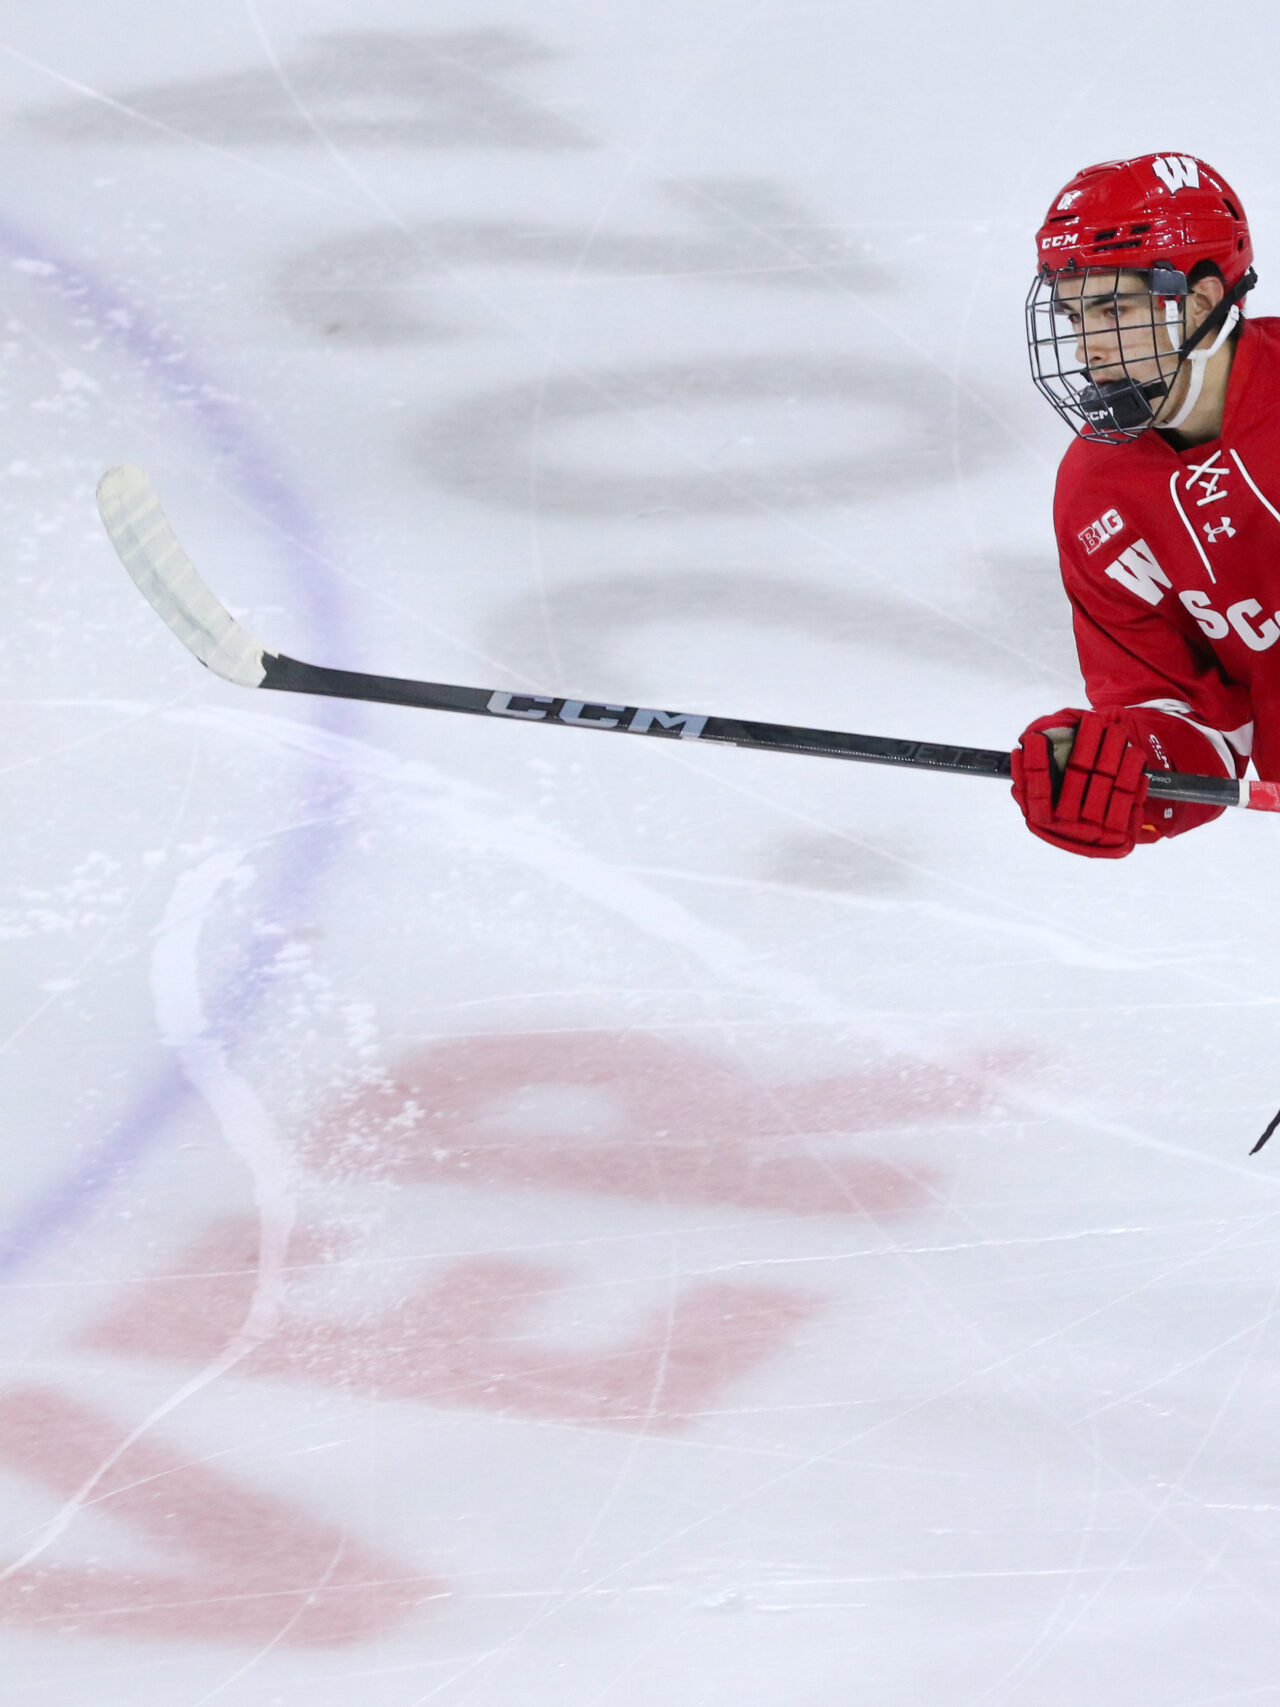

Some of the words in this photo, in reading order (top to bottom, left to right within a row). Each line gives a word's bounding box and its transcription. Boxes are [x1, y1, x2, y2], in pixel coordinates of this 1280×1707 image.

[1152, 155, 1200, 196] W
[1041, 233, 1079, 249] CCM
[487, 690, 709, 738] CCM
